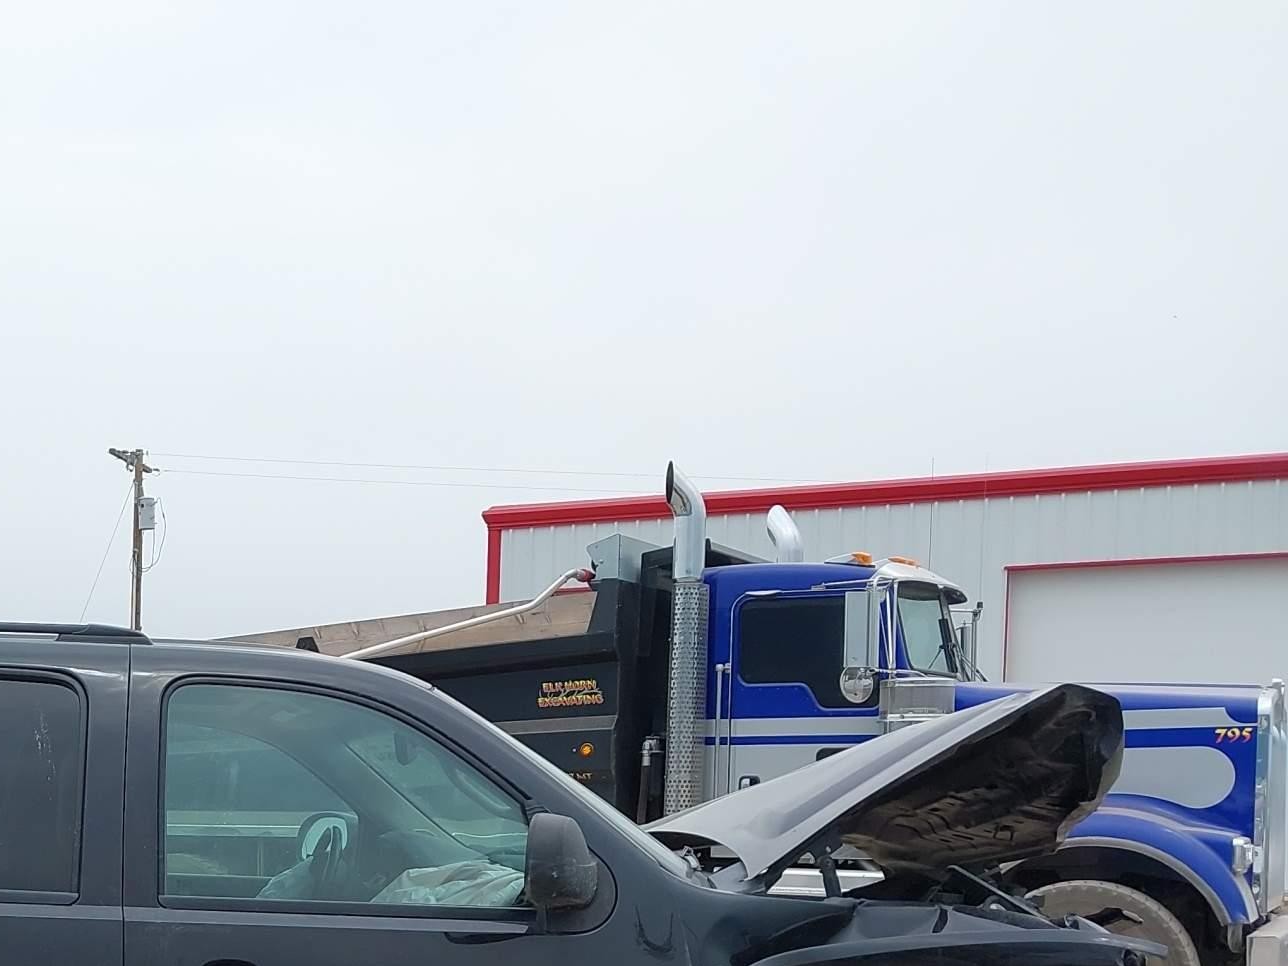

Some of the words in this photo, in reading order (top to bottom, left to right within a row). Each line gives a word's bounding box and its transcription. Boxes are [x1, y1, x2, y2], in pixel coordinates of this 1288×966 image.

[564, 679, 597, 690] HORN
[537, 694, 604, 708] EXCAVATING
[1214, 727, 1253, 743] 795
